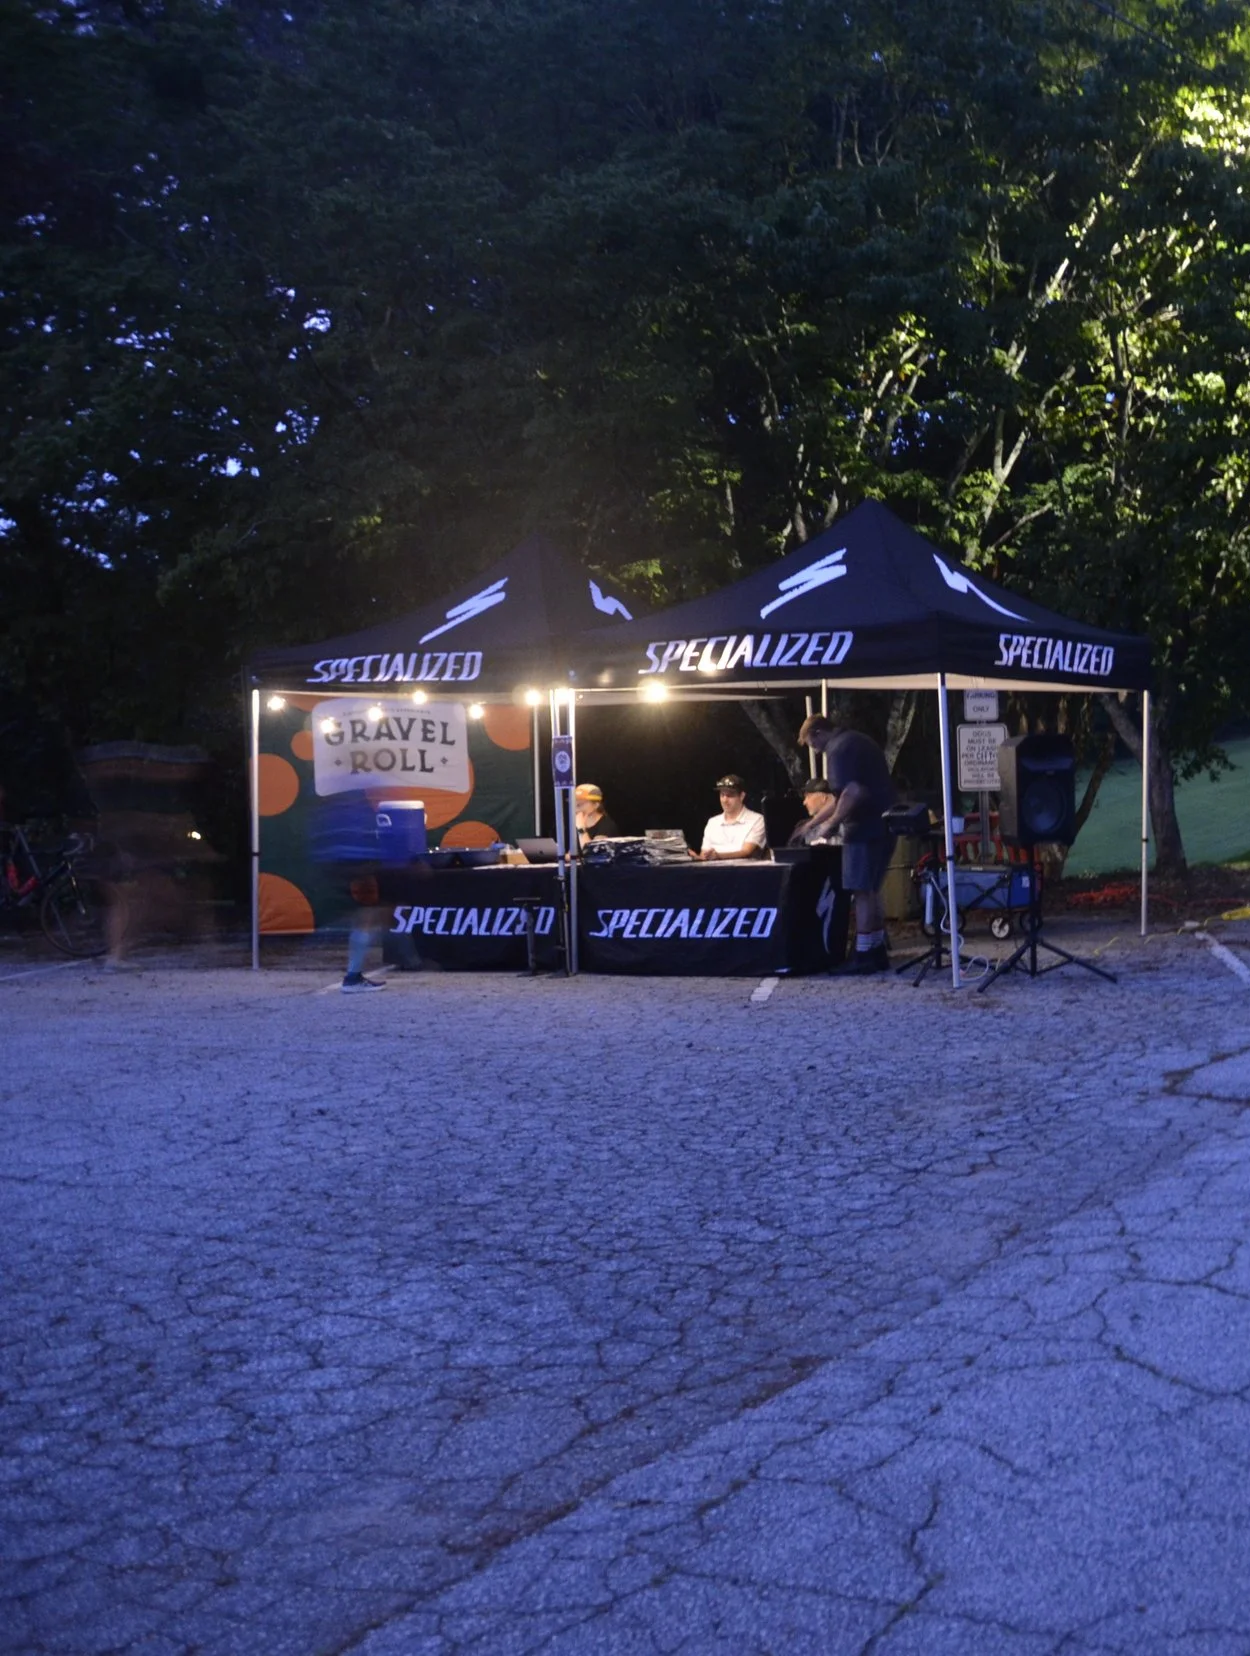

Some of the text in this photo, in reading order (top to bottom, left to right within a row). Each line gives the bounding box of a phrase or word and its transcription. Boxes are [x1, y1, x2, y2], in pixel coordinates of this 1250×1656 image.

[306, 651, 483, 683] SPECIALIZED
[638, 631, 854, 675] SPECIALIZED
[994, 633, 1115, 676] SPECIALIZED
[972, 705, 990, 713] ONLY
[324, 717, 456, 746] GRAVEL
[350, 748, 434, 775] ROLL
[589, 907, 778, 938] SPECIALIZED
